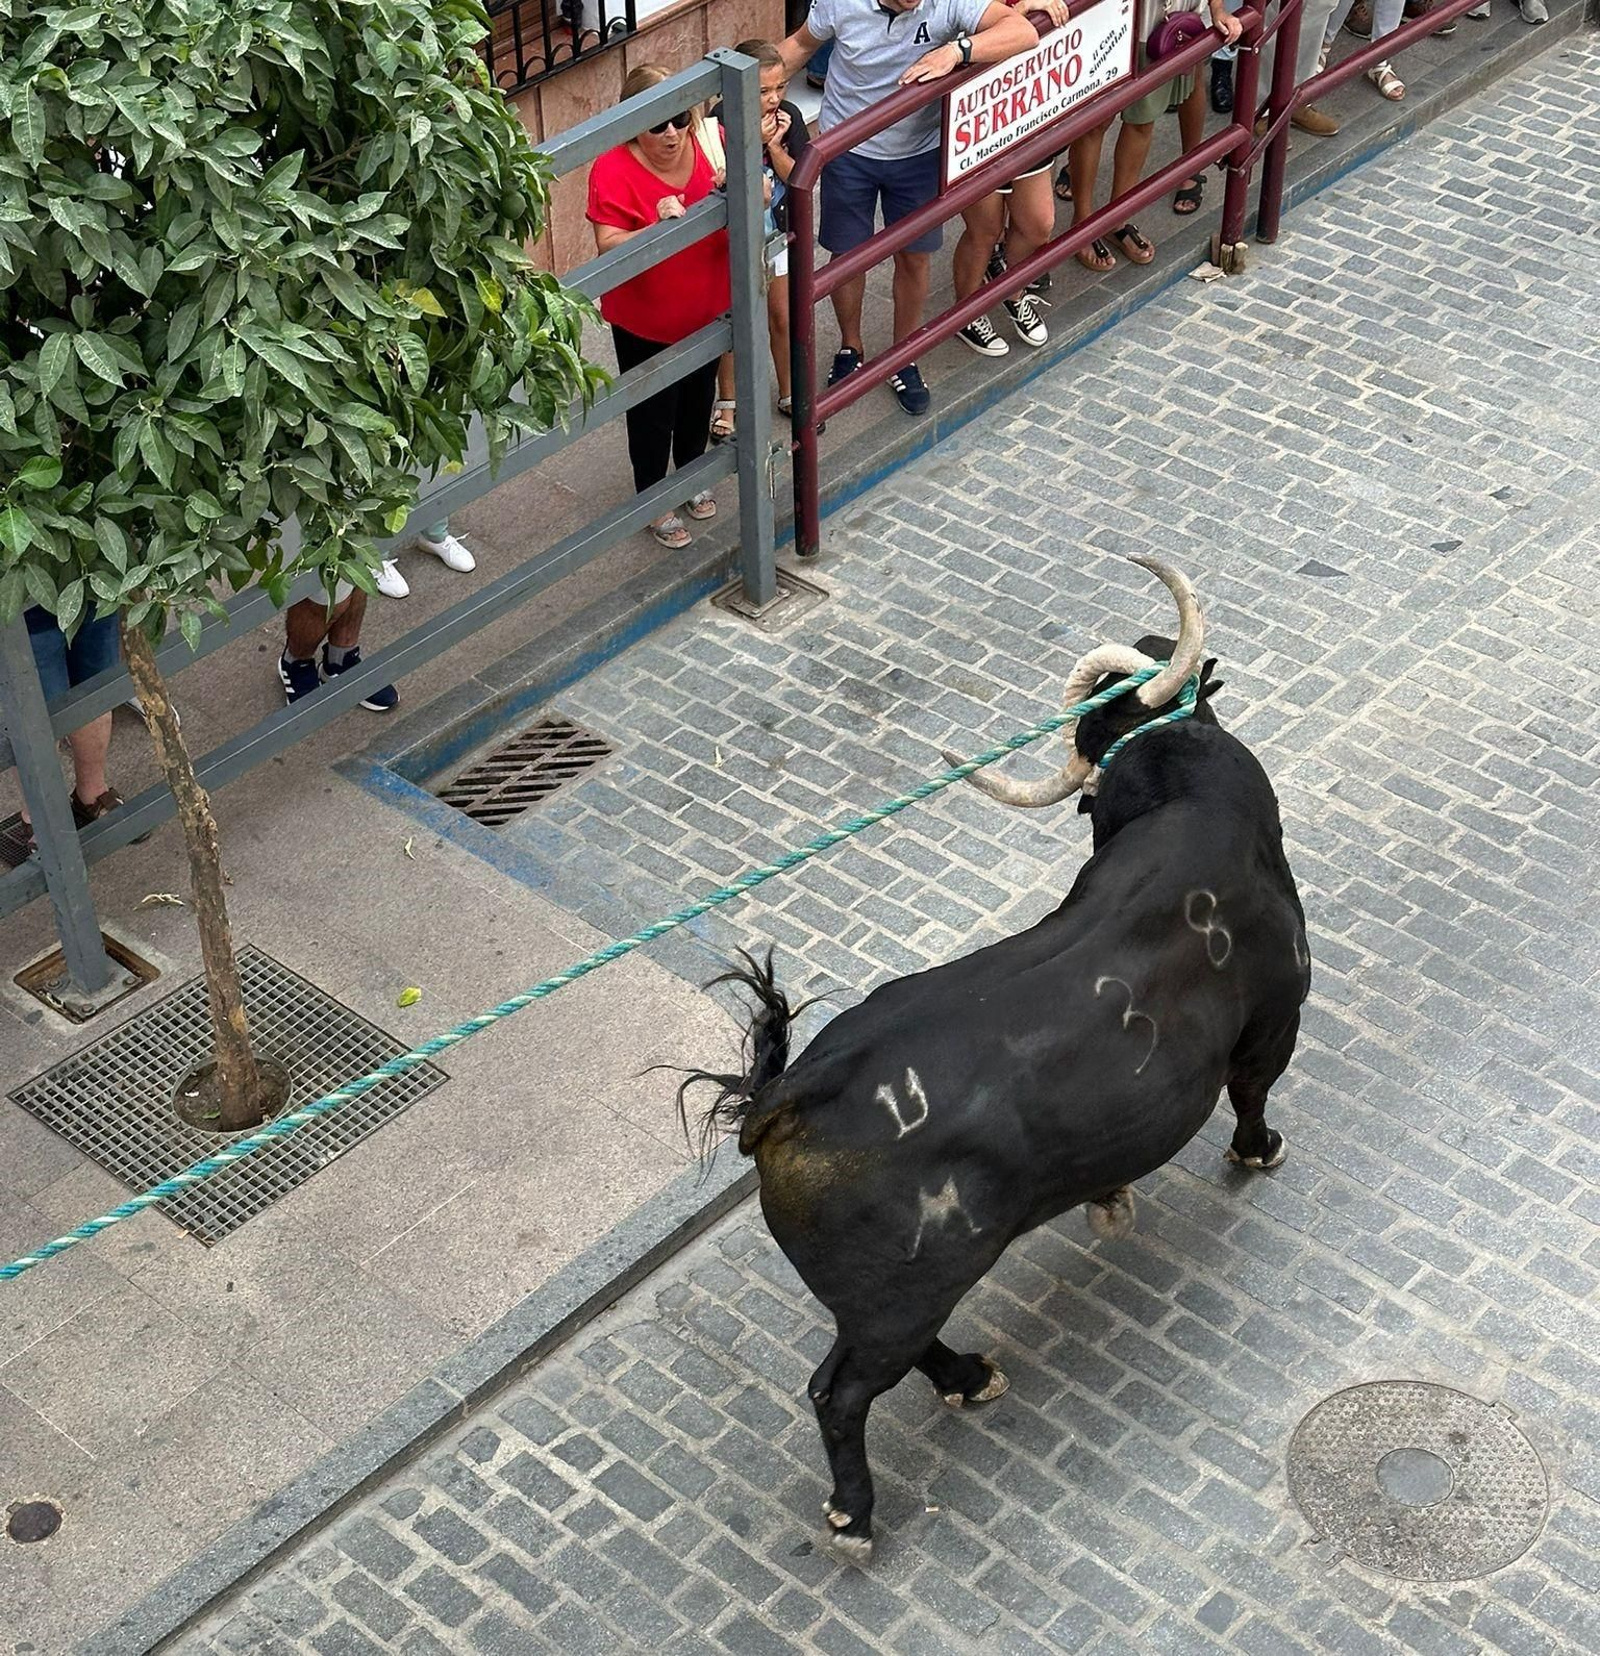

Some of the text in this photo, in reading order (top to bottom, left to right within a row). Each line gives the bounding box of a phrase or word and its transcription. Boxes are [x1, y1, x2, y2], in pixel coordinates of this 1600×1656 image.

[913, 21, 931, 45] A
[954, 28, 1083, 122] AUTOSERVICIO
[954, 53, 1083, 156] SERRANO
[976, 132, 1013, 162] Maestro
[1015, 104, 1059, 137] Francisco
[1060, 78, 1103, 109] Carmona,
[1105, 66, 1119, 82] 29
